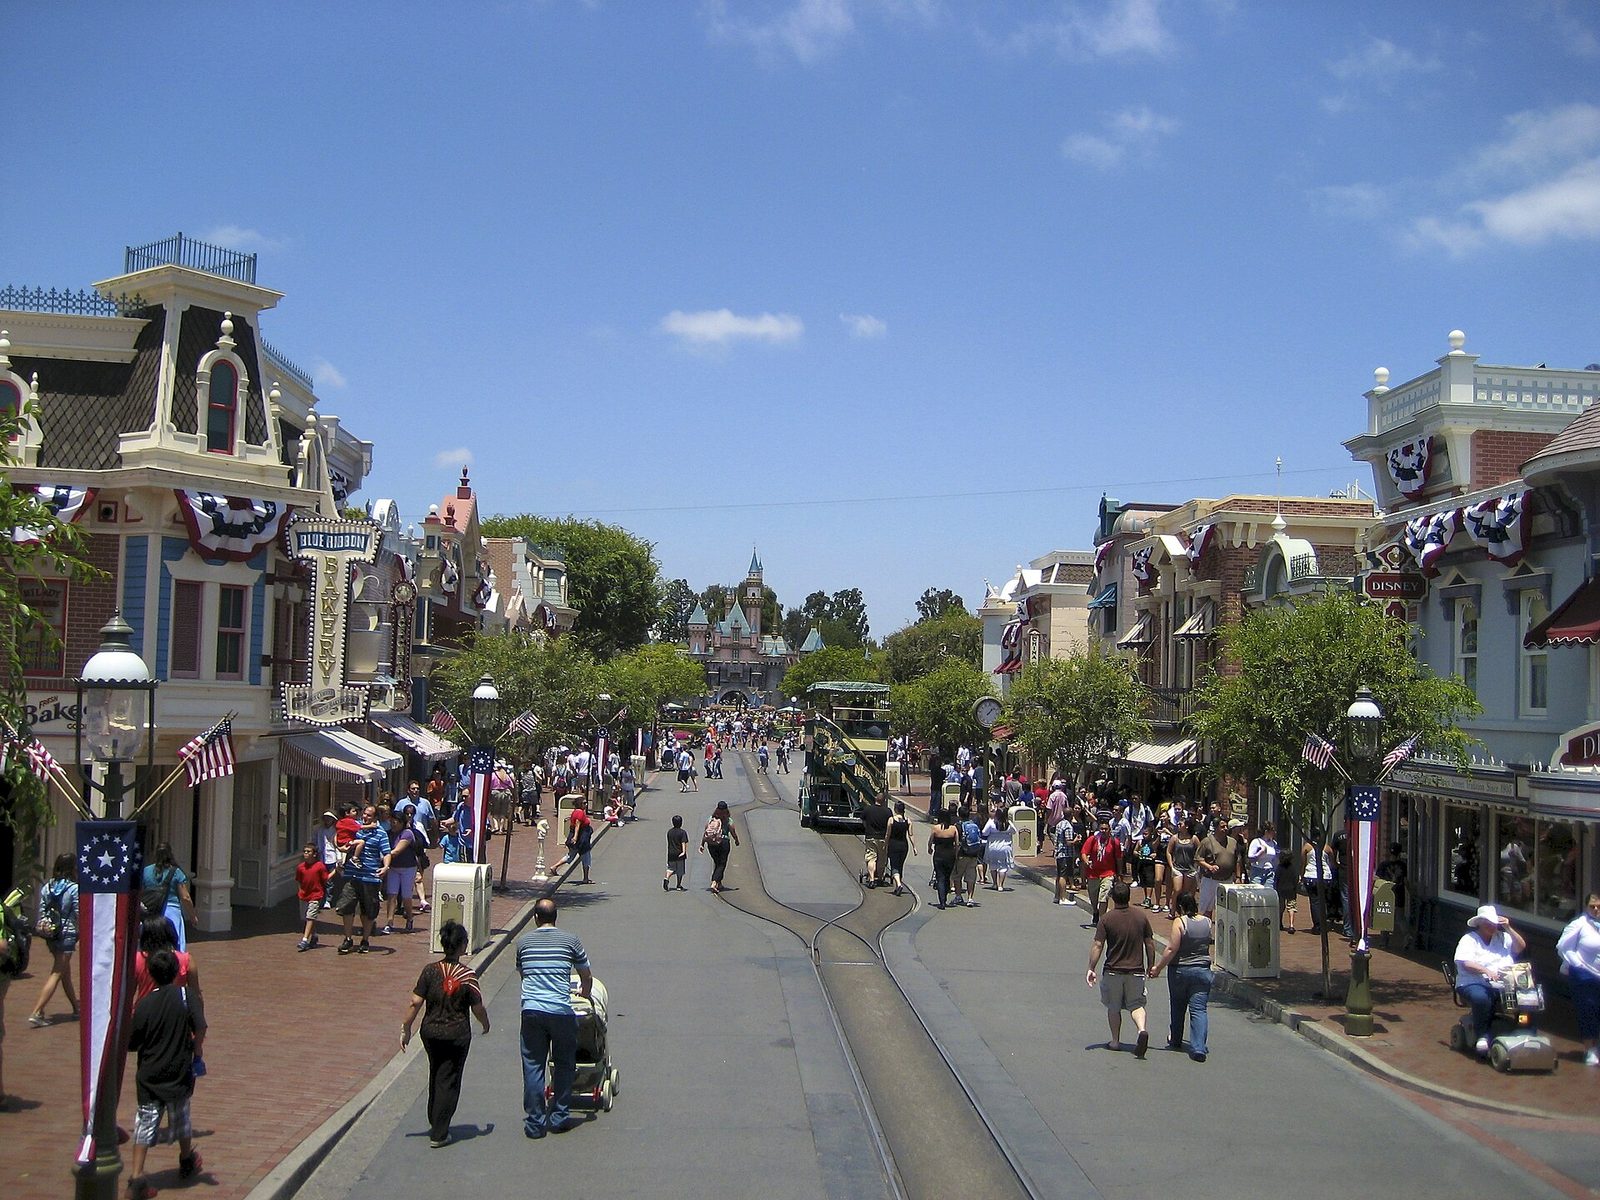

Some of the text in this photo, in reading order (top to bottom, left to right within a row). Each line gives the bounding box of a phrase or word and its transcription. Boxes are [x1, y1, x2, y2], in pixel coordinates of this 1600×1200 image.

[300, 534, 364, 549] BLUE RIBBON
[1372, 581, 1418, 592] DISNEY
[319, 556, 338, 680] BAKERY
[39, 695, 58, 709] FRESH
[21, 703, 87, 726] Bake
